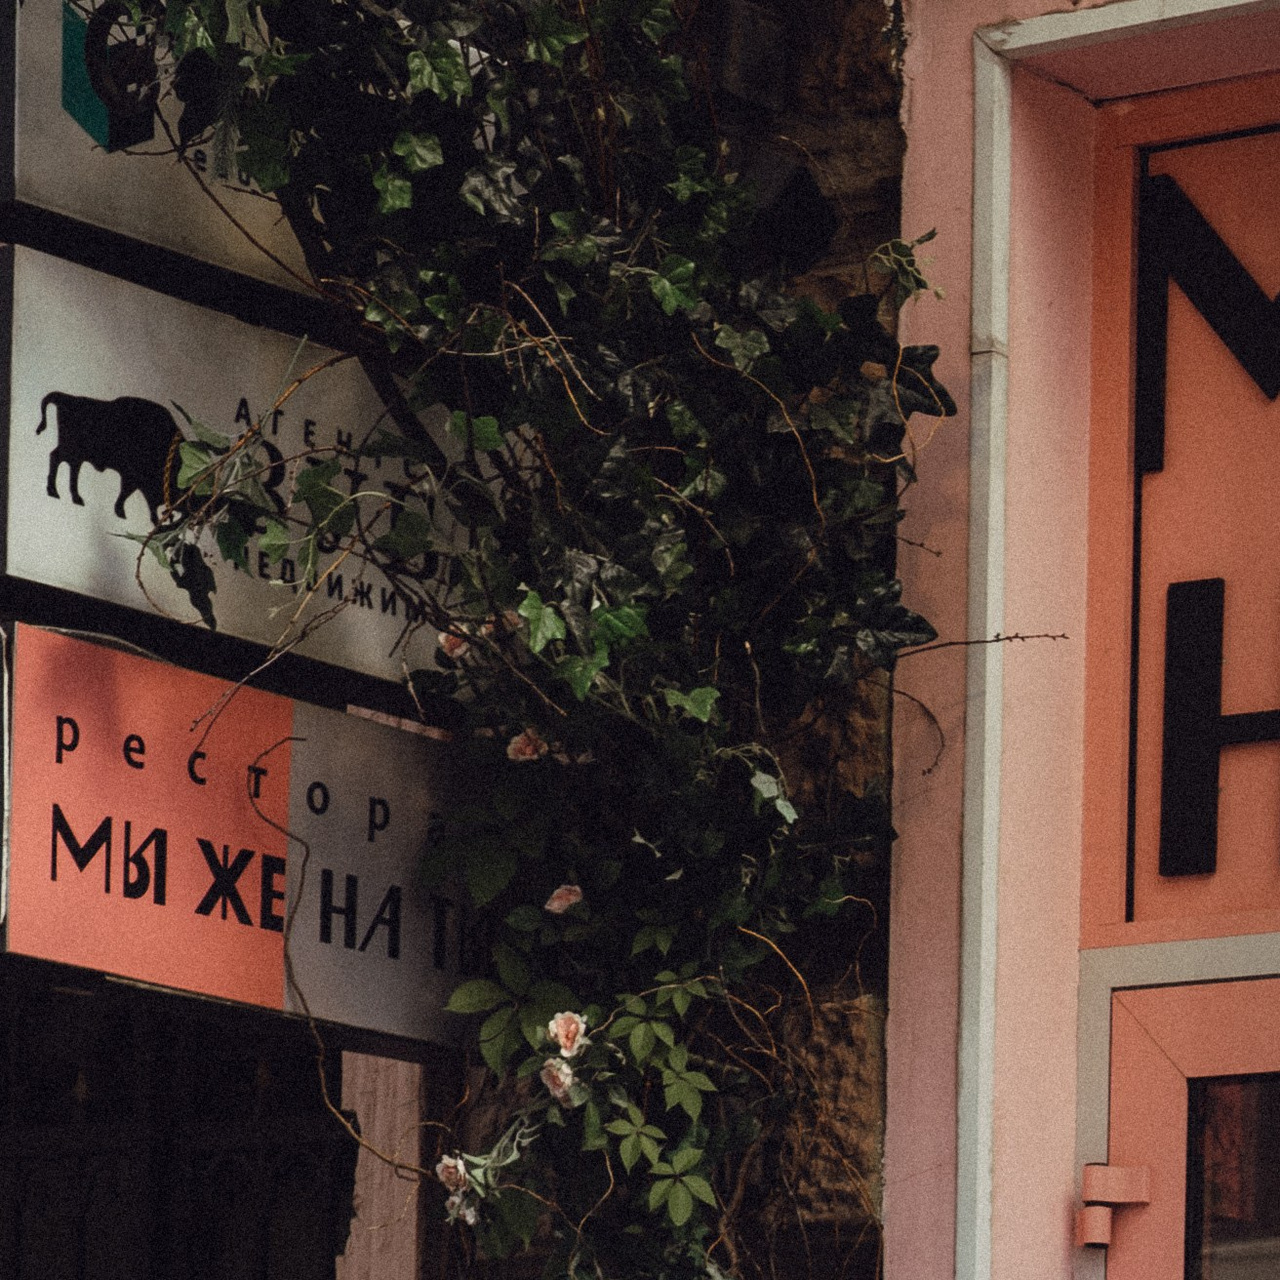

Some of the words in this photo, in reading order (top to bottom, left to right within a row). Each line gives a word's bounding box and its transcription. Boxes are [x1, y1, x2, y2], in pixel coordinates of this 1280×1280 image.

[50, 803, 167, 905] МЫ
[195, 837, 286, 933] ЖЕ
[319, 868, 401, 959] НА
